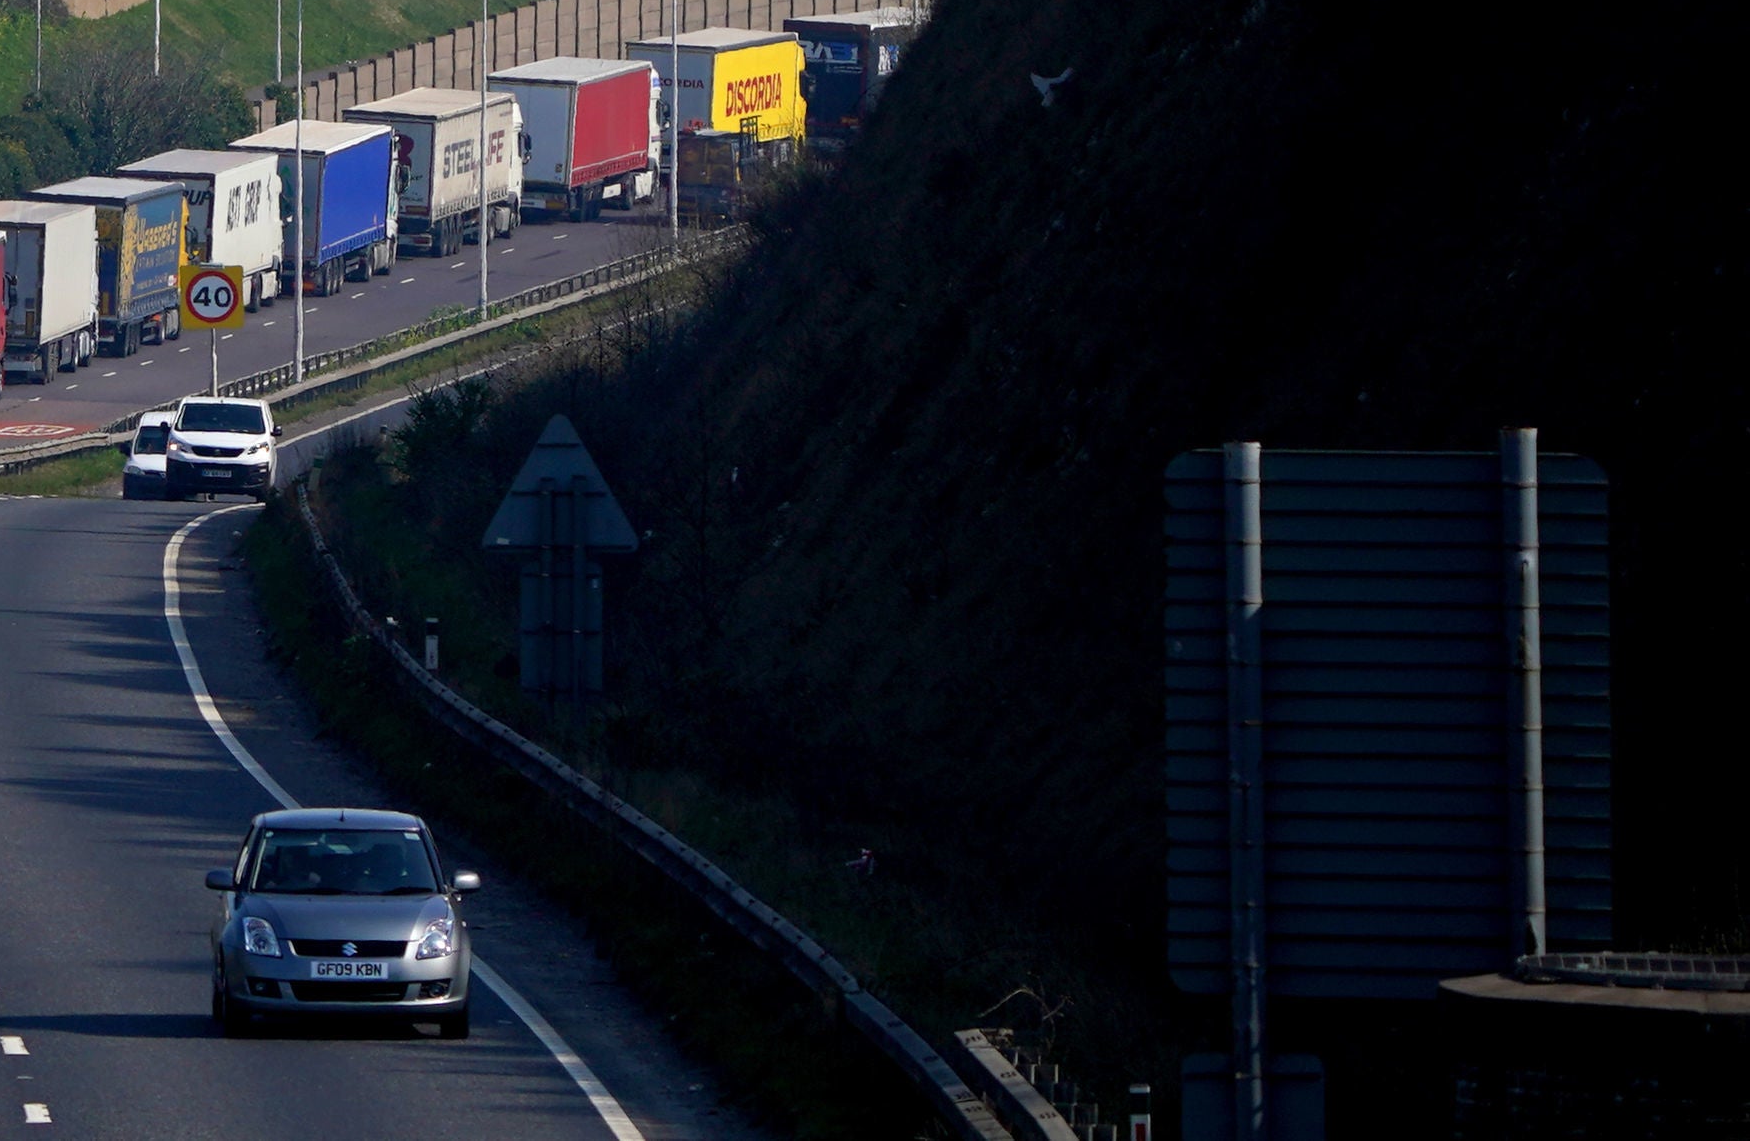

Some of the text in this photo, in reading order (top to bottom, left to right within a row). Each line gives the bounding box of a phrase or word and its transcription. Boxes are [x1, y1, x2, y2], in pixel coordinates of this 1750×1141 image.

[726, 73, 782, 117] DISCORDIA
[443, 139, 475, 179] STEEL
[193, 286, 231, 308] 40
[317, 963, 382, 976] GF09 KBN
